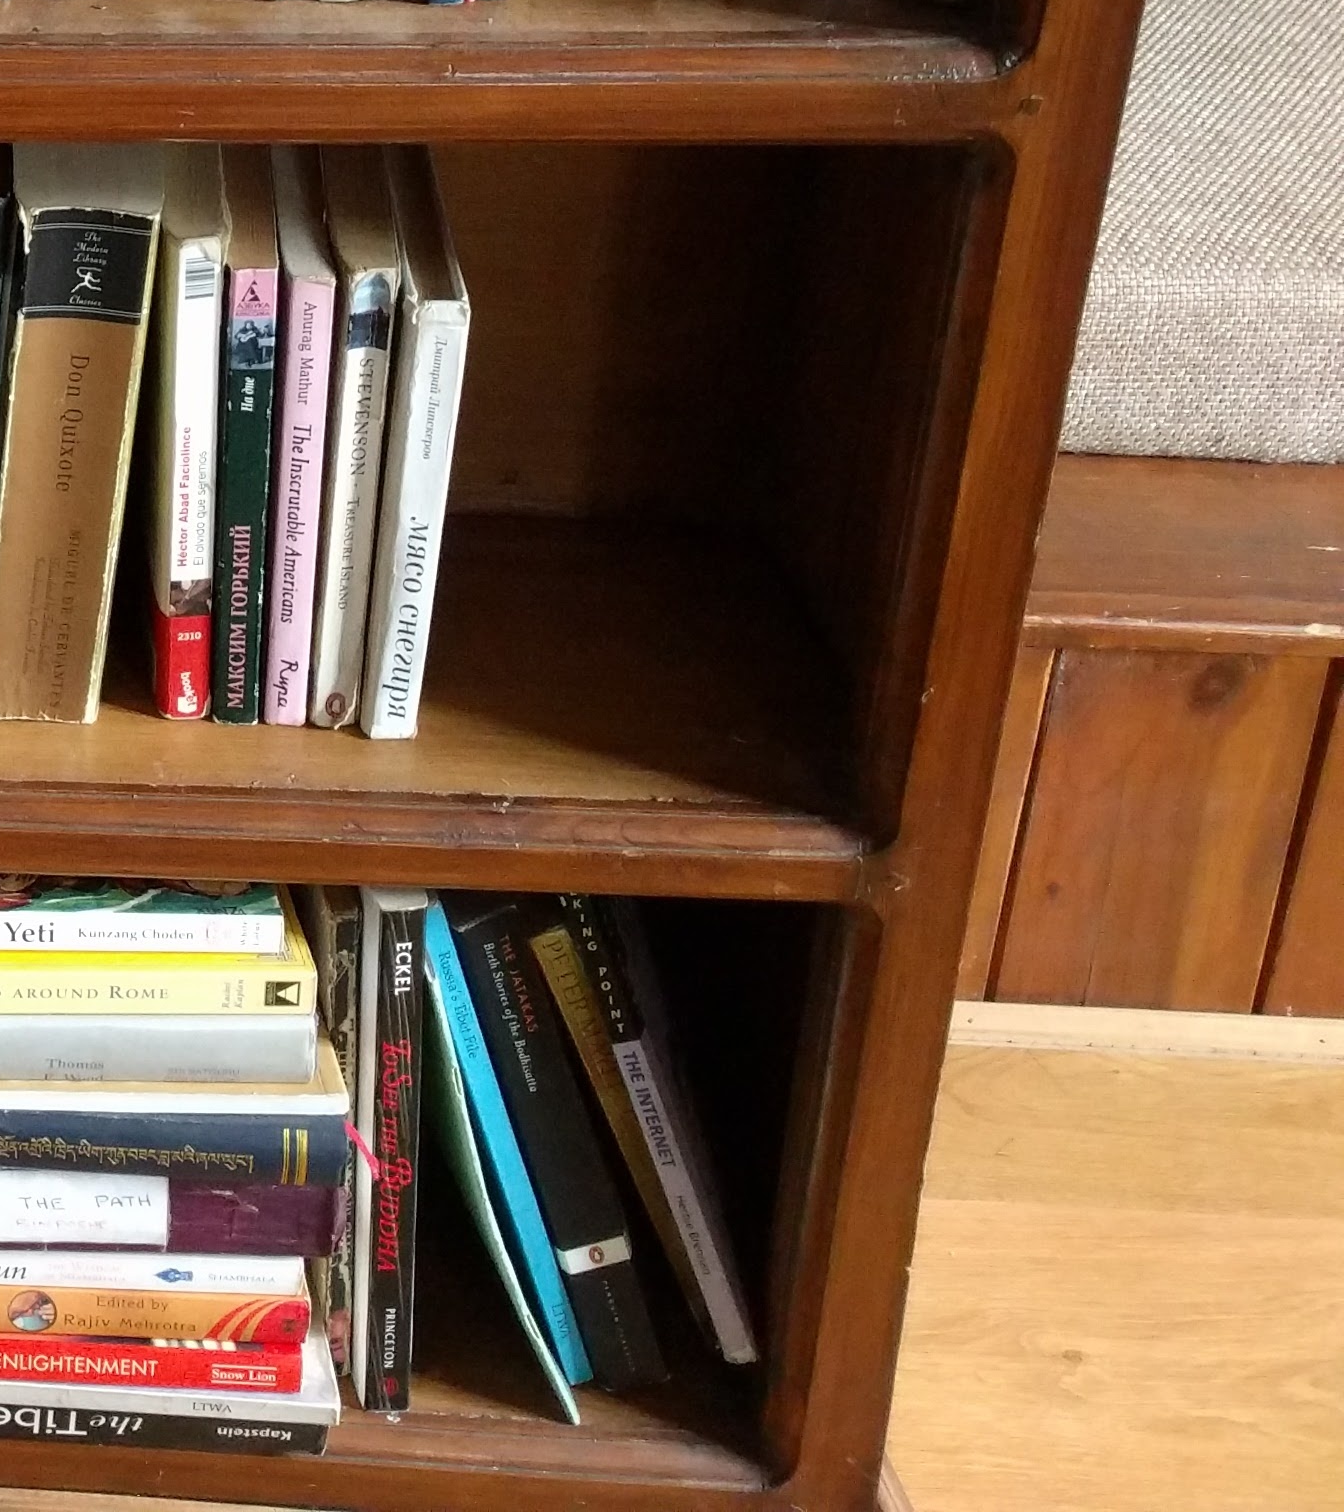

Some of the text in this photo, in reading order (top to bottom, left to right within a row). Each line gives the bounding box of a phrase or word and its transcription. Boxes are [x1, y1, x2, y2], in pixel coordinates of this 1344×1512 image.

[350, 357, 375, 476] STEVENSON
[177, 426, 191, 566] Héctor Abad Faciolince
[279, 424, 312, 624] The Inscrutable Americans
[226, 524, 252, 710] МАКСИМ ГОРЬКИЙ
[385, 516, 430, 719] мясо снегиря
[4, 920, 56, 945] Yeti
[77, 926, 194, 942] Kunzang Choden
[394, 941, 412, 996] ECKEL
[622, 1050, 677, 1168] THE INTERNET
[18, 1194, 152, 1211] THE PATH
[382, 1306, 397, 1369] PRINCETON
[90, 1411, 144, 1432] the
[217, 1425, 292, 1442] Kapstein
